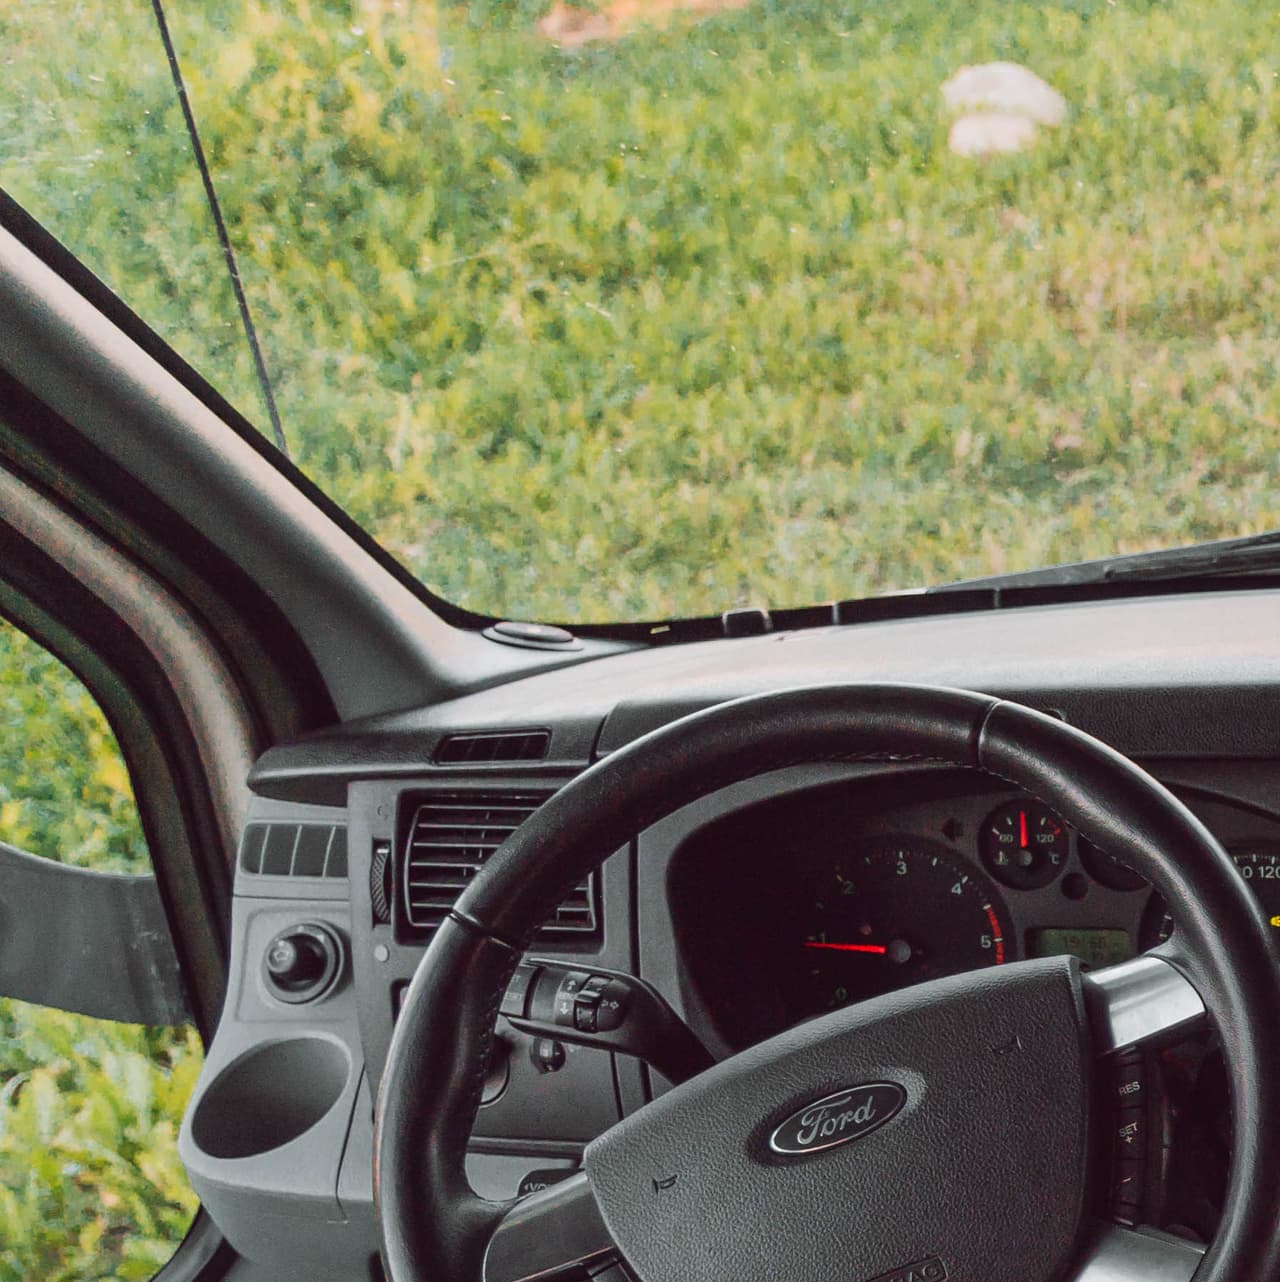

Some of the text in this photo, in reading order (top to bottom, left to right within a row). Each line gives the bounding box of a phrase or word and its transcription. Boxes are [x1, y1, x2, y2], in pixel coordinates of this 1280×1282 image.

[896, 861, 908, 876] 3
[842, 881, 855, 895] 2
[951, 882, 963, 895] 4
[980, 935, 992, 950] 5
[1118, 1081, 1141, 1096] RES
[797, 1096, 876, 1144] Ford
[1118, 1121, 1138, 1138] SET
